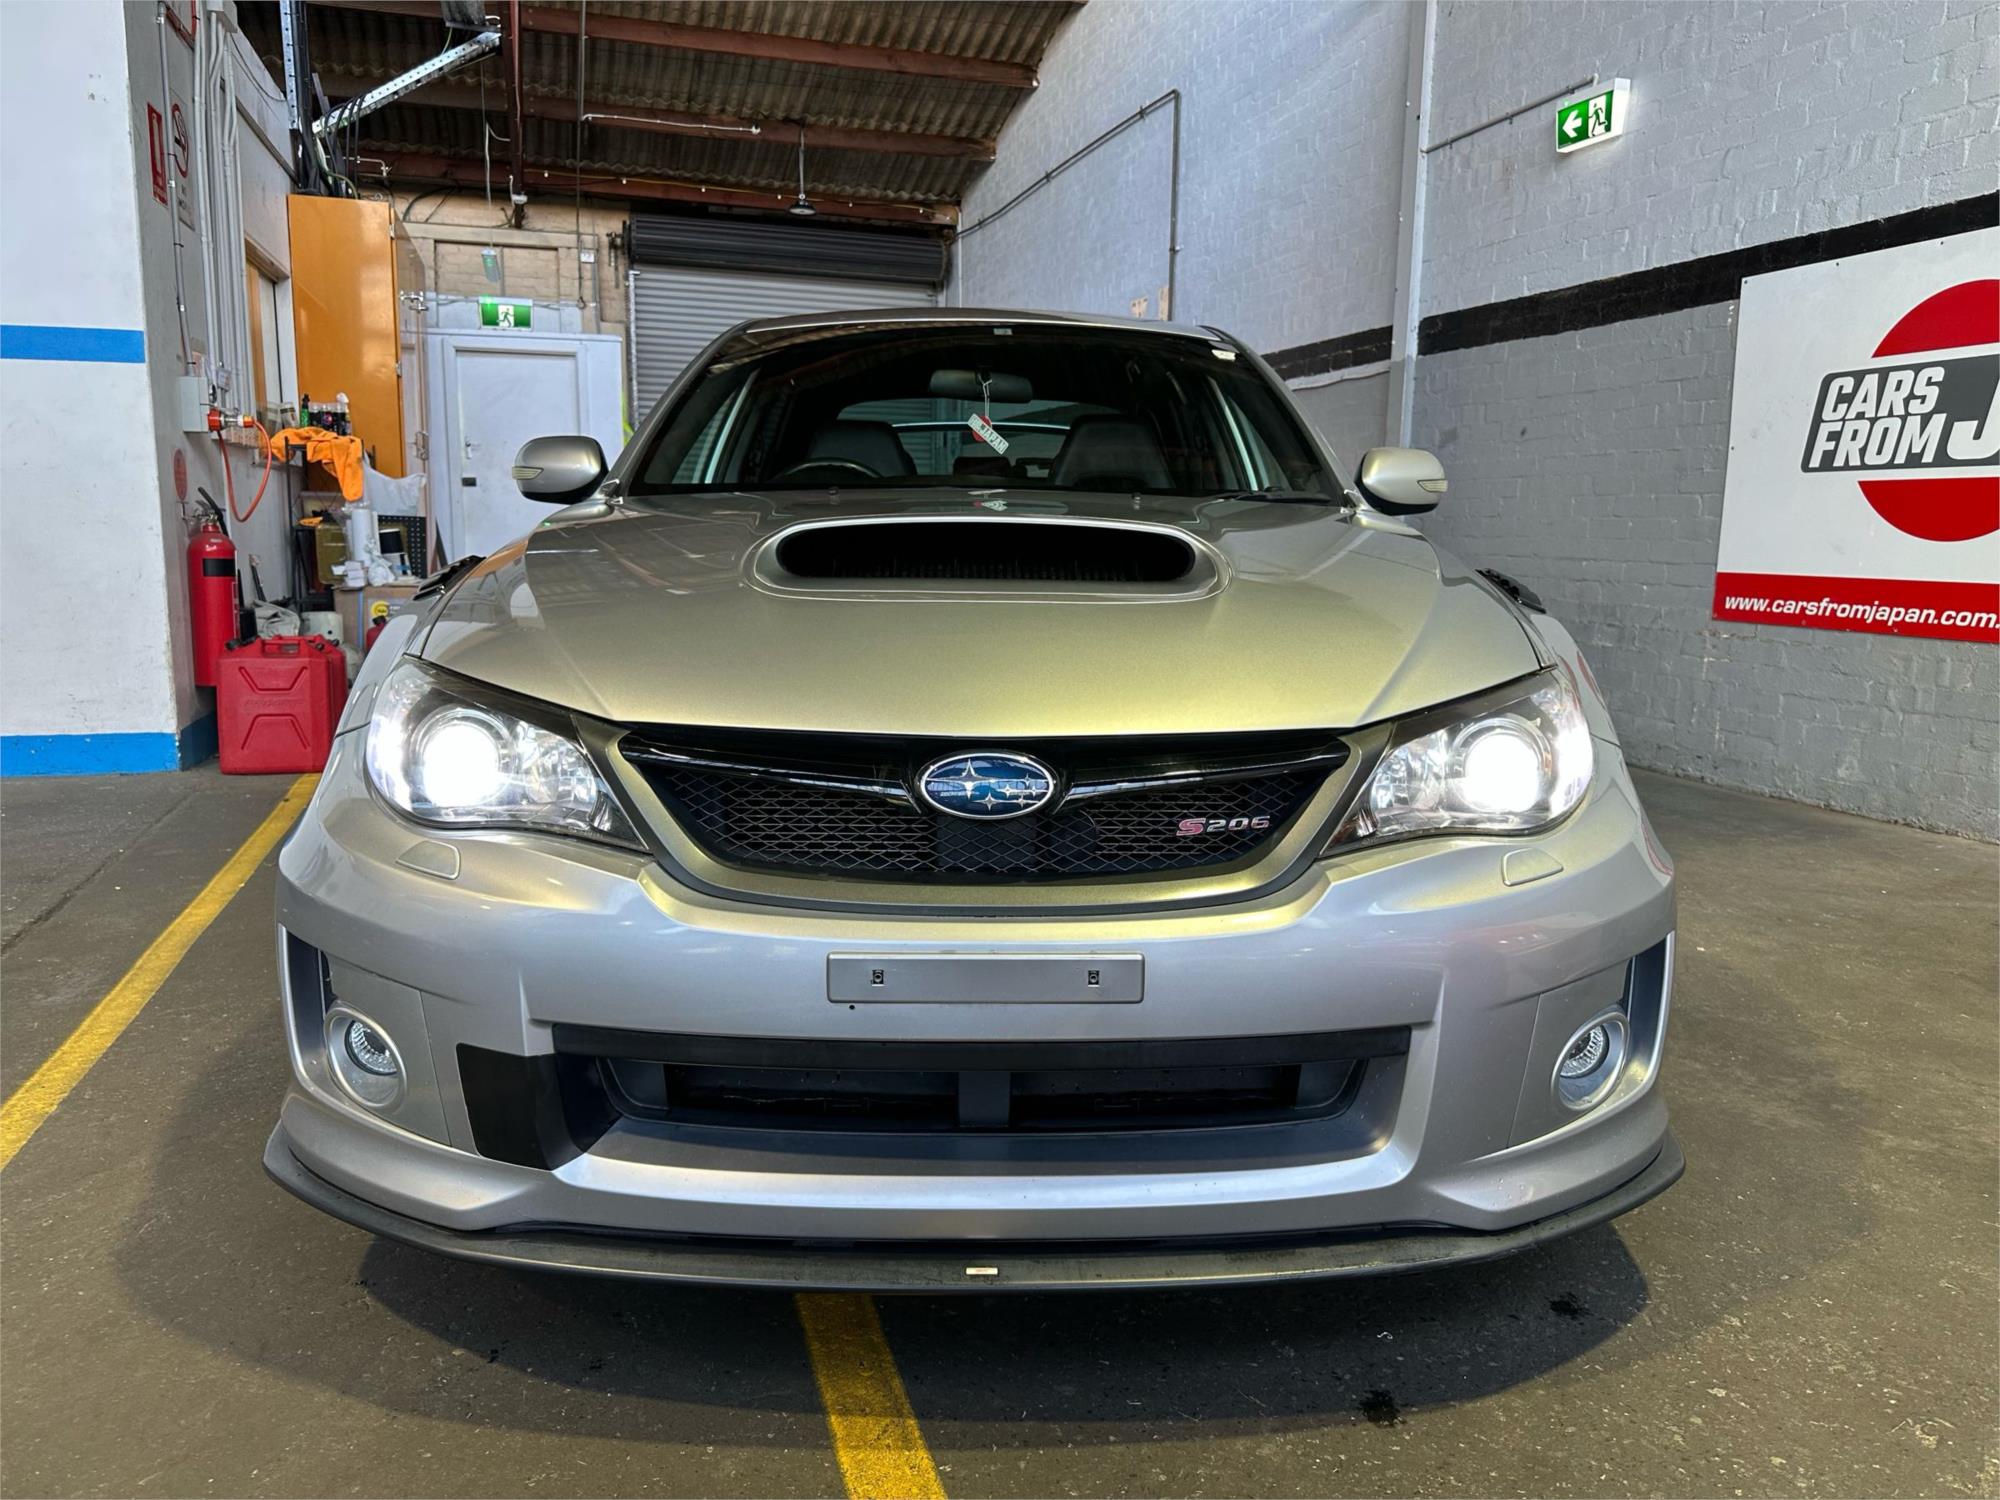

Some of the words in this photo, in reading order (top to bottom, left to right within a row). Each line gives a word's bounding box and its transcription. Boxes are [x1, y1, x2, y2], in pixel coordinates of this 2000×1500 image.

[1821, 366, 1945, 422] CARS
[1808, 413, 1947, 468] FROM
[1175, 815, 1271, 837] S206
